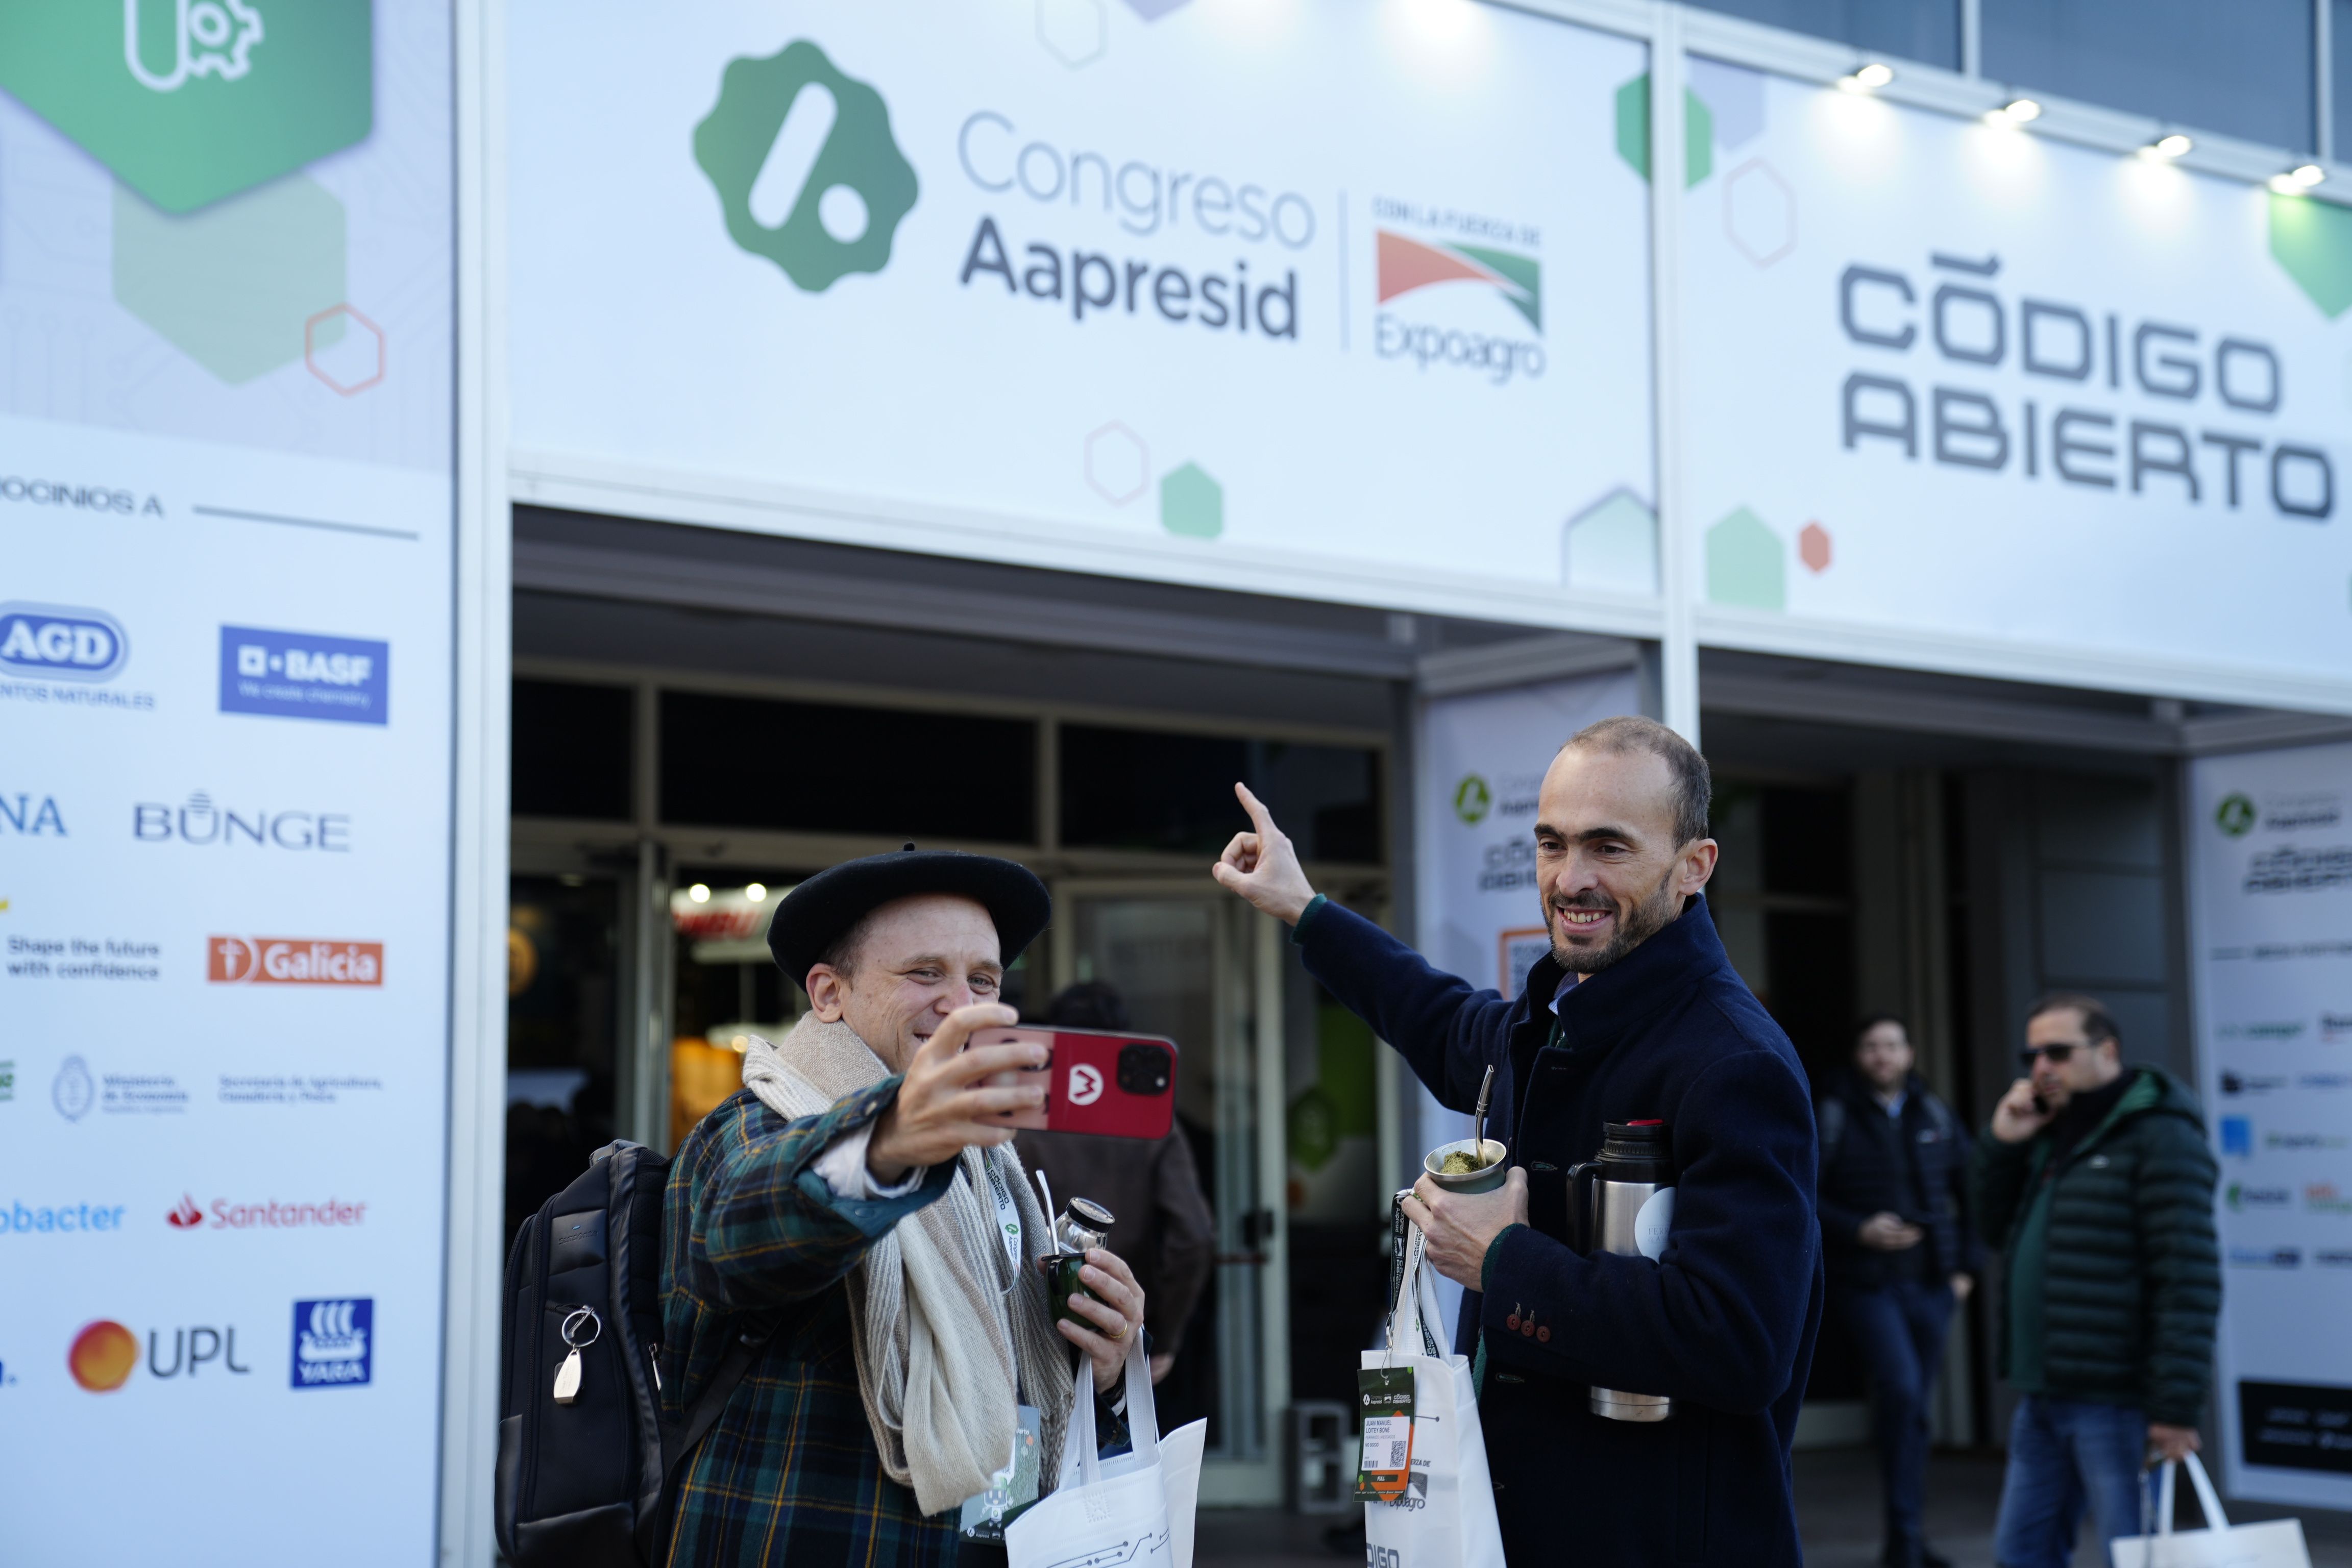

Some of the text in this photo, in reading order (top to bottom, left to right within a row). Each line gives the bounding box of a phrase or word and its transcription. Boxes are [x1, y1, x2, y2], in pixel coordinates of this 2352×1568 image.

[957, 109, 1317, 251] Congreso
[960, 214, 1300, 343] Aapresid
[1376, 312, 1547, 386] Expoagro
[1841, 371, 2337, 523] ABIERTO
[139, 492, 165, 521] A
[2, 619, 112, 667] AGD
[285, 649, 373, 686] BASF
[52, 685, 157, 712] NATURALES
[133, 799, 352, 854] BUNGE
[7, 936, 160, 959] Shape the future
[263, 942, 378, 982] Galicia
[7, 960, 160, 981] with confidence
[987, 1172, 1006, 1211] ABIERTO
[210, 1195, 368, 1230] Santander
[148, 1323, 251, 1380] UPL
[299, 1361, 365, 1384] YARA
